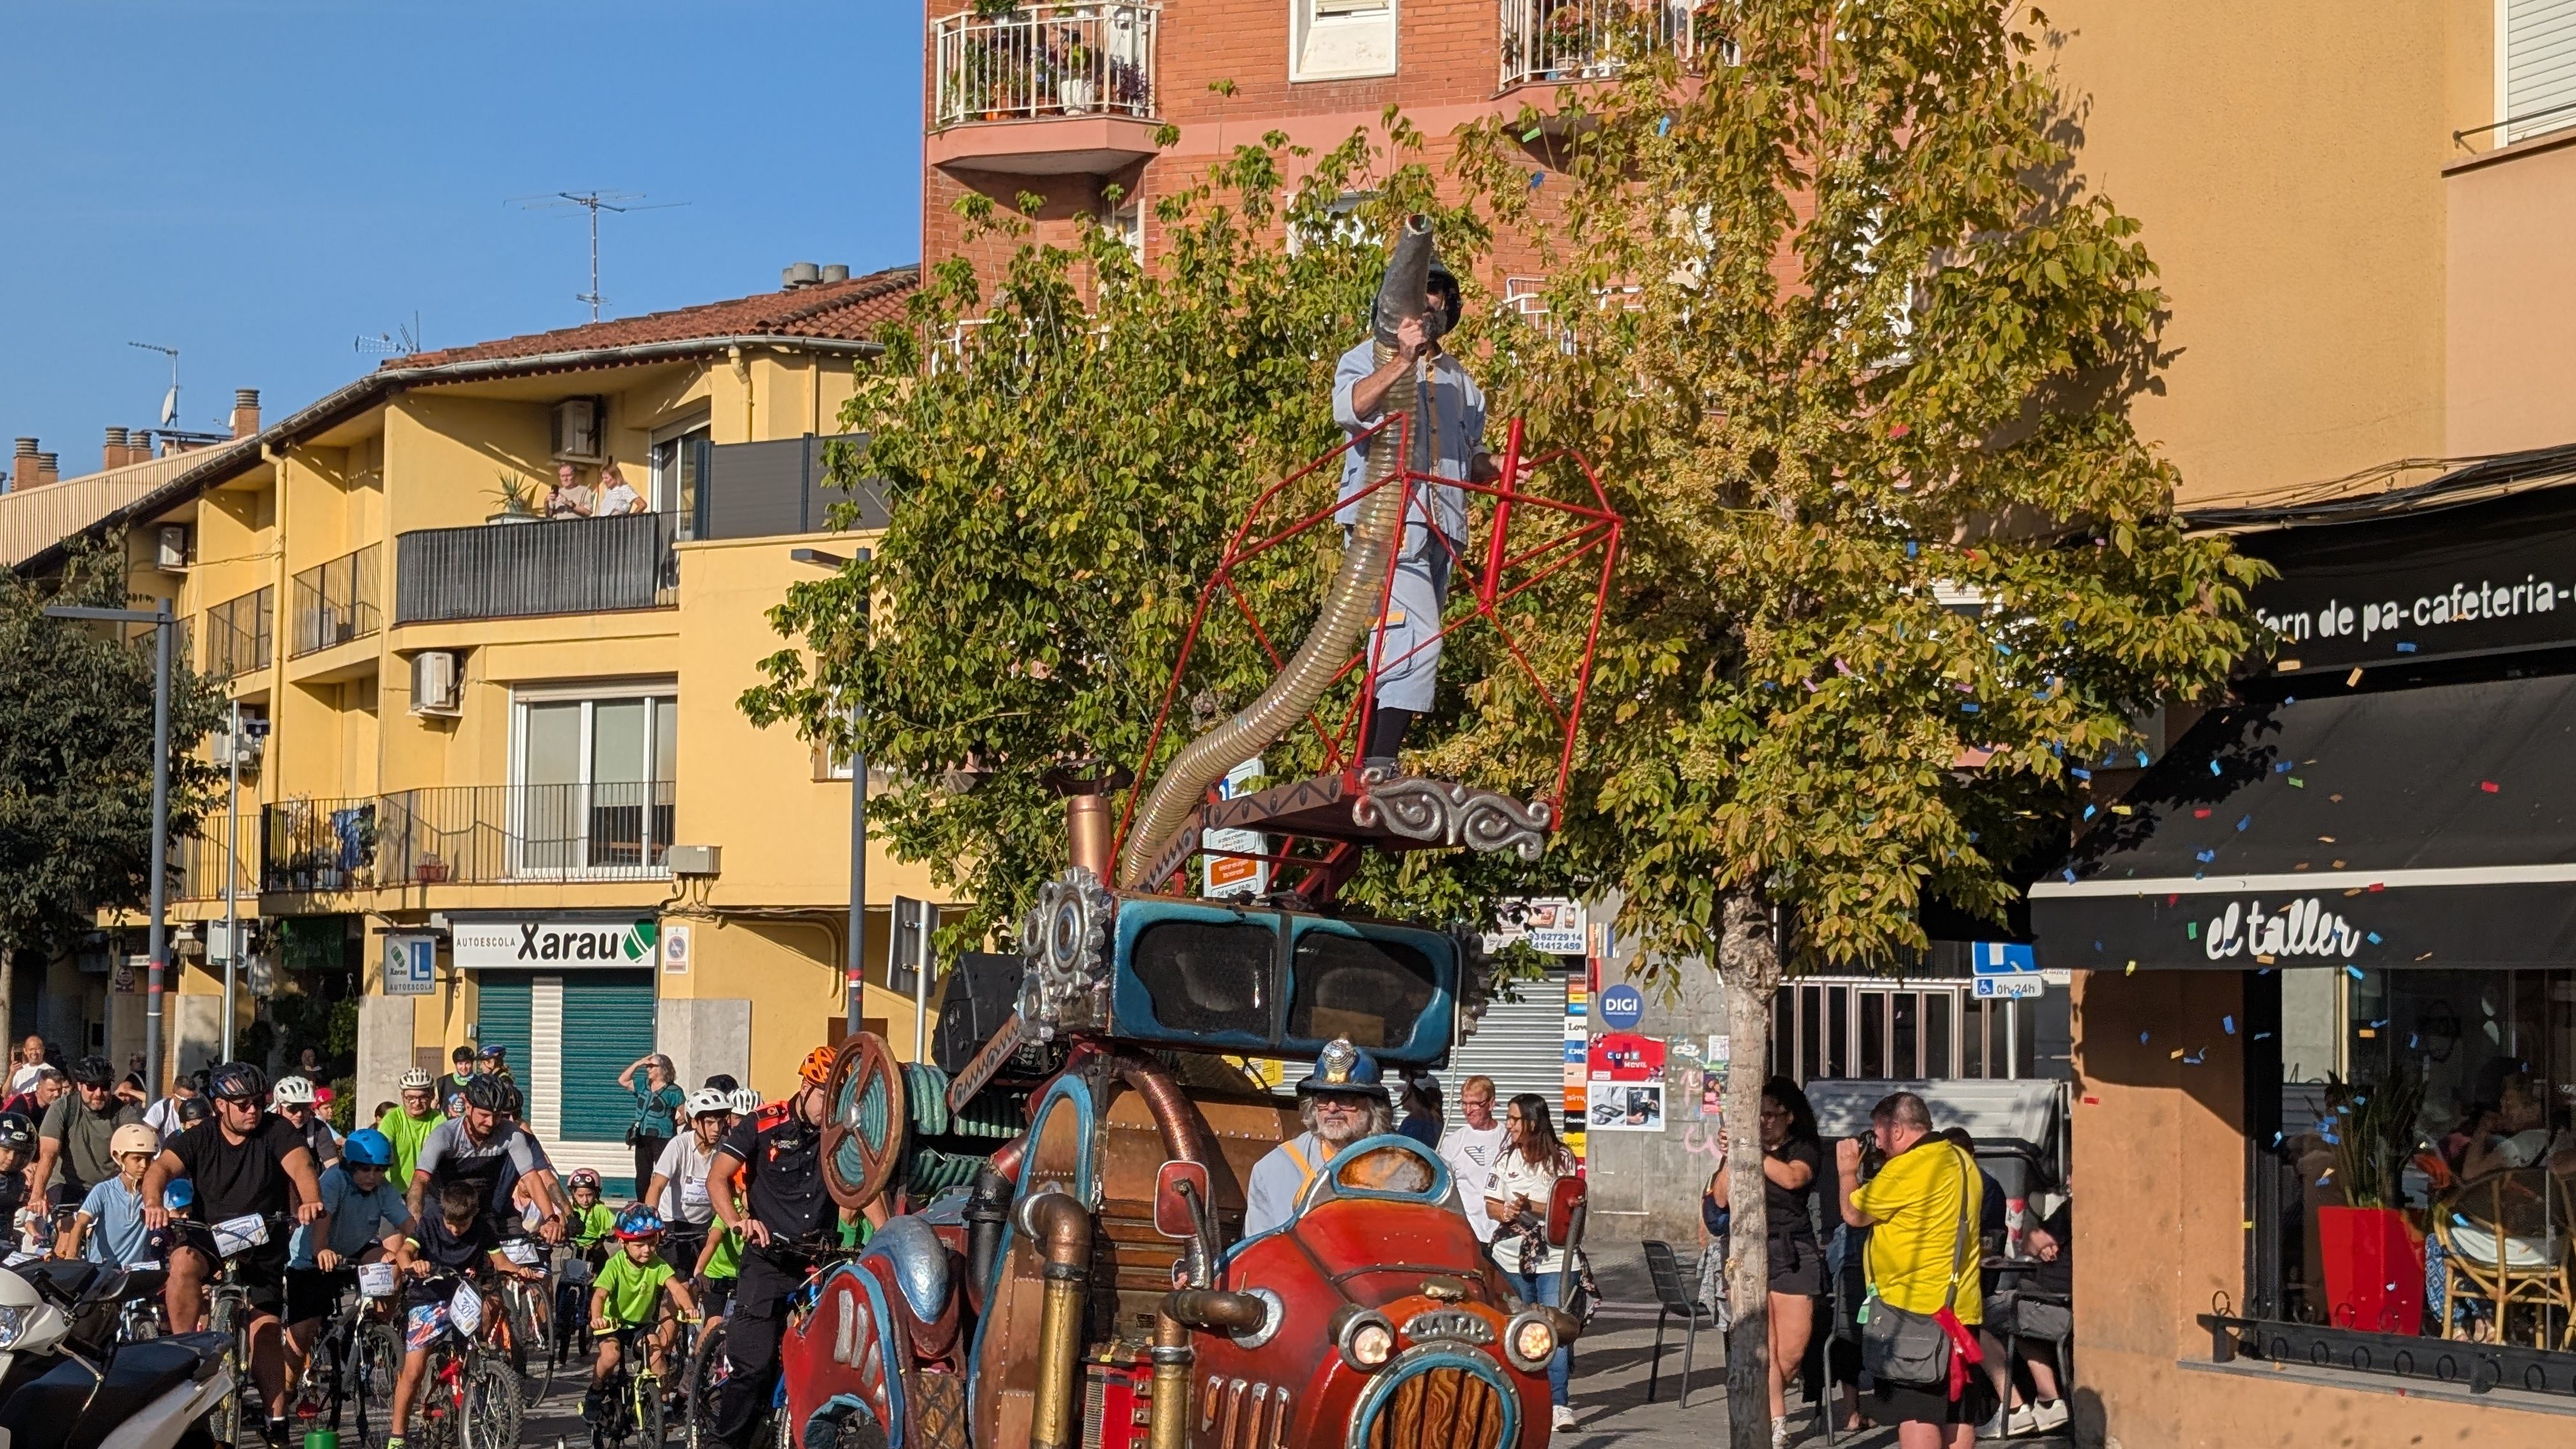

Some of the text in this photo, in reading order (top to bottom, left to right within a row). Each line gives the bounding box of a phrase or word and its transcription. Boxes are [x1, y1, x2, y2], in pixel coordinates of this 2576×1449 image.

[2319, 599, 2354, 637] de
[2363, 574, 2576, 642] pa-cafeteria-
[456, 923, 618, 960] AUTOESCOLA Xarau
[2206, 898, 2361, 960] el taller
[1606, 998, 1637, 1011] DIGI
